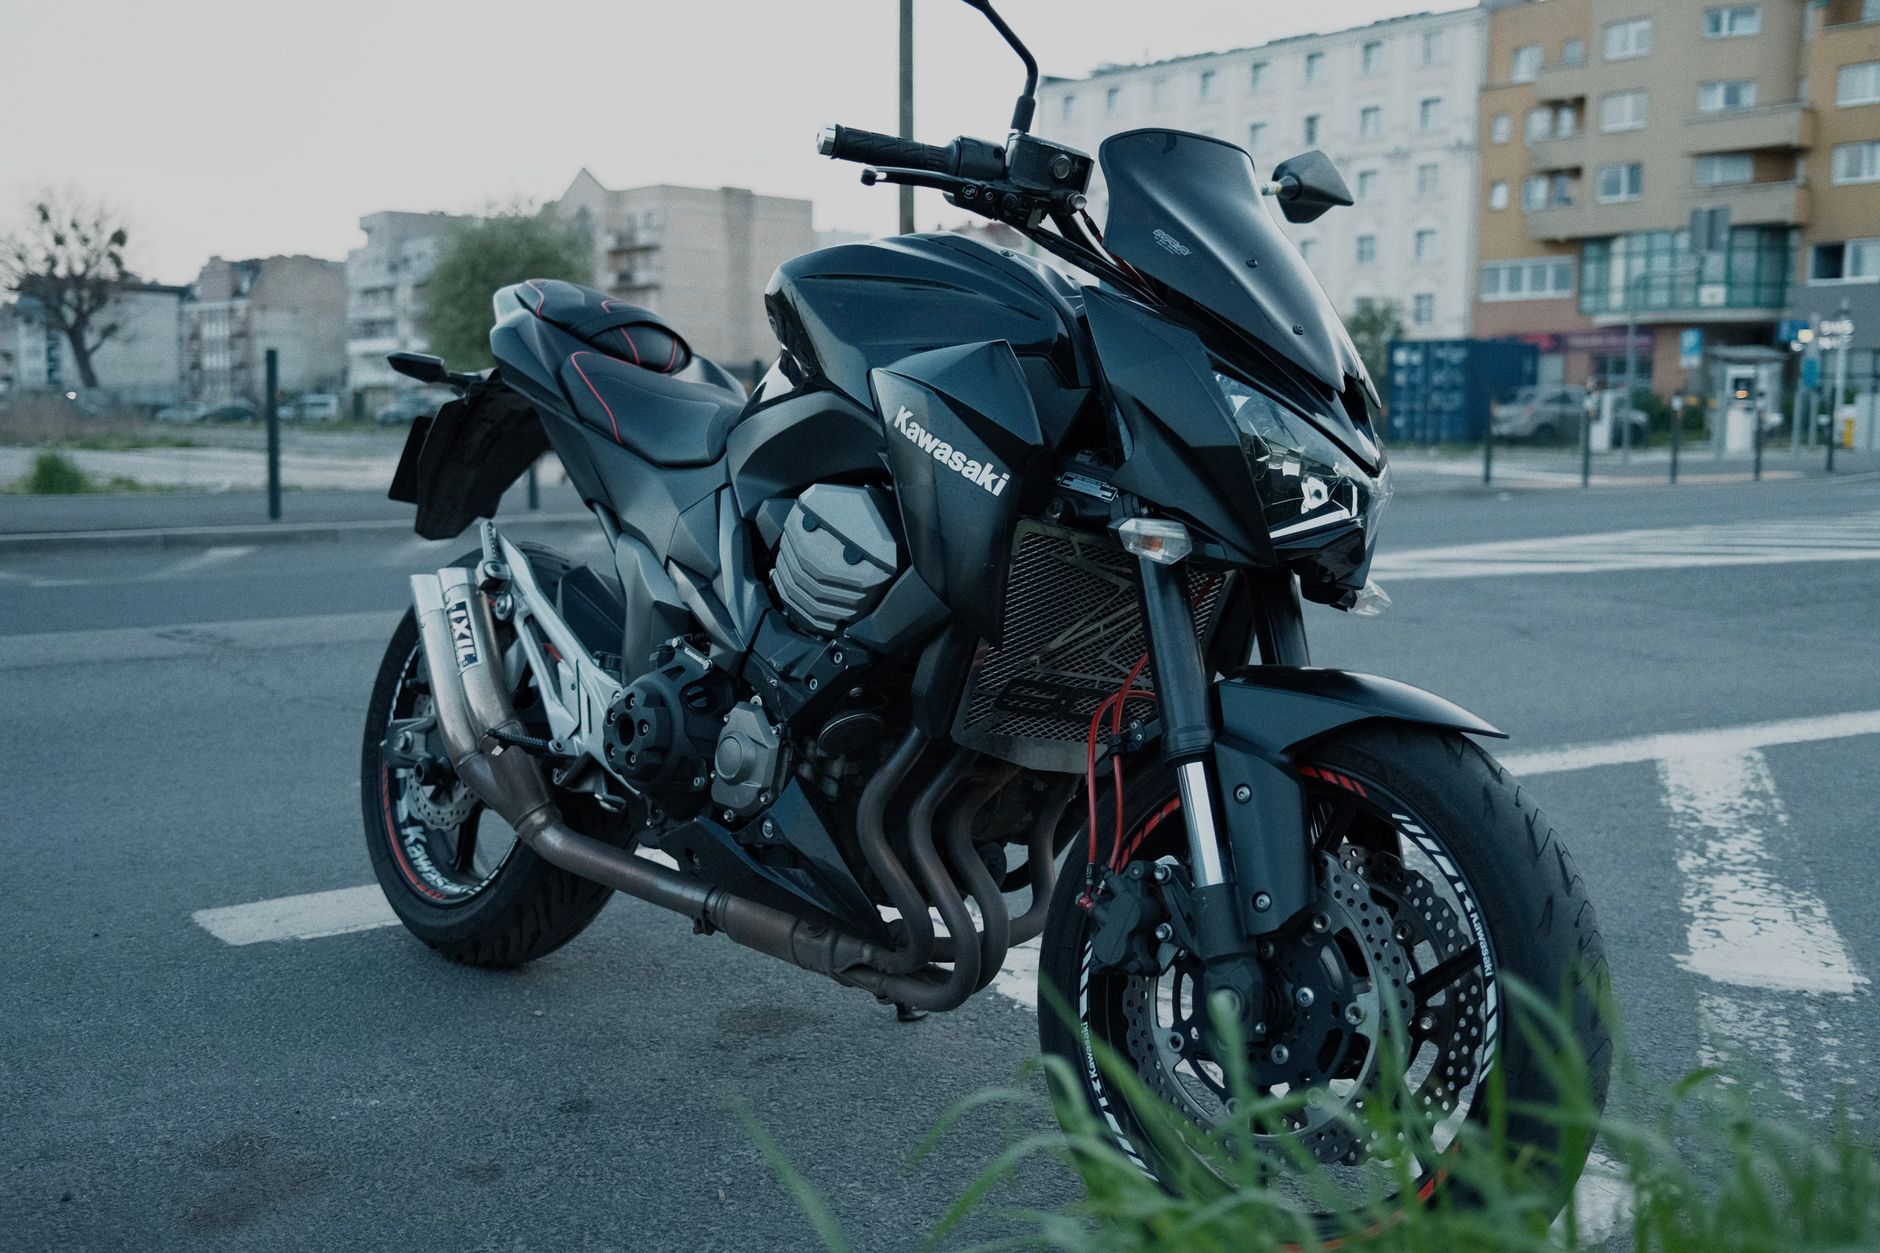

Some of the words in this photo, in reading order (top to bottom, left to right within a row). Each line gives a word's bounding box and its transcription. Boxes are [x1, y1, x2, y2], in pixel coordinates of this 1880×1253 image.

[894, 405, 1010, 496] Kawasaki
[449, 609, 475, 664] IXIL
[1470, 911, 1494, 977] Kawasaki
